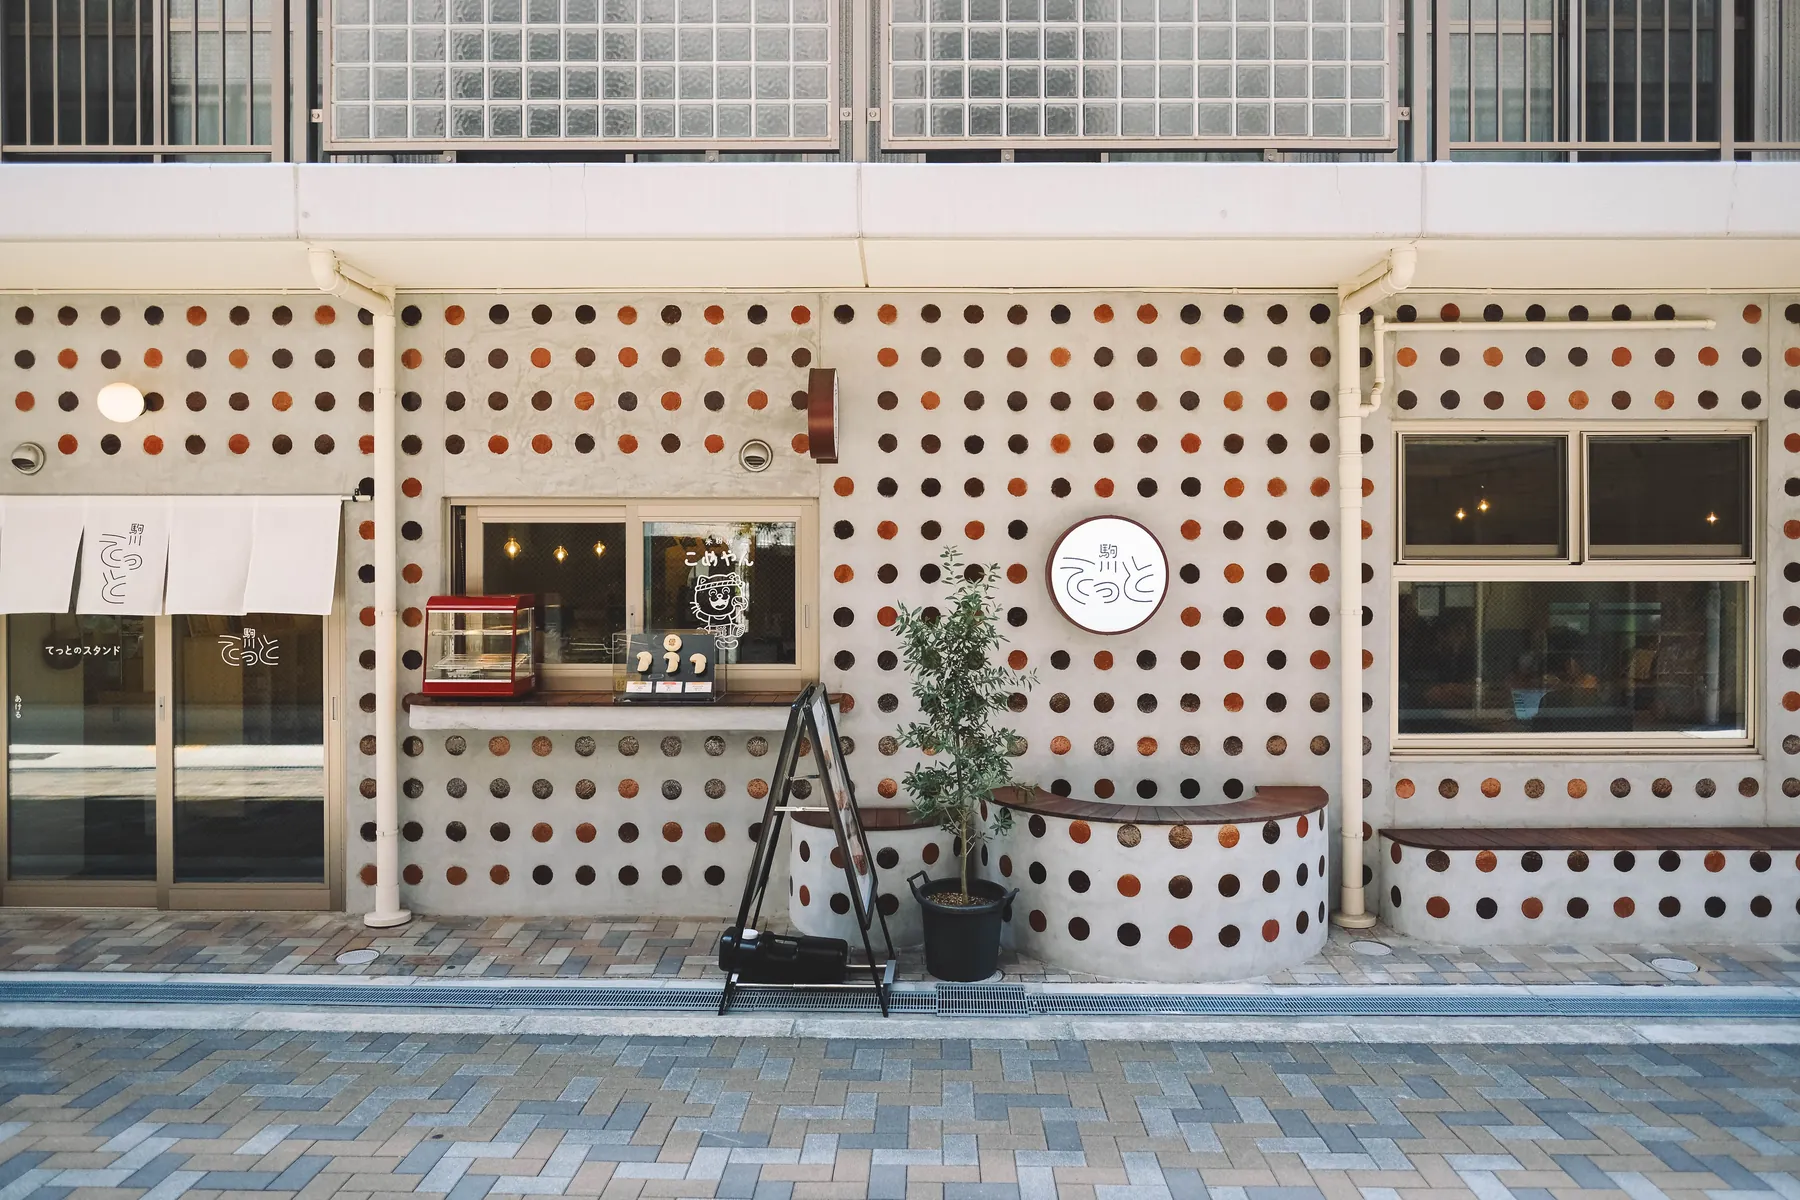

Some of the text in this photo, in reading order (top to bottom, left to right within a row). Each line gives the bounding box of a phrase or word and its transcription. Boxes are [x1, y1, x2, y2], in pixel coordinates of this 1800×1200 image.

[129, 523, 144, 546] 駒川
[99, 533, 143, 604] てっと
[684, 550, 754, 567] こめやん
[1099, 543, 1118, 573] 駒川
[1060, 556, 1154, 605] てっと
[45, 645, 121, 656] てっとのスタンド
[217, 634, 279, 667] てっと
[14, 695, 22, 719] あける
